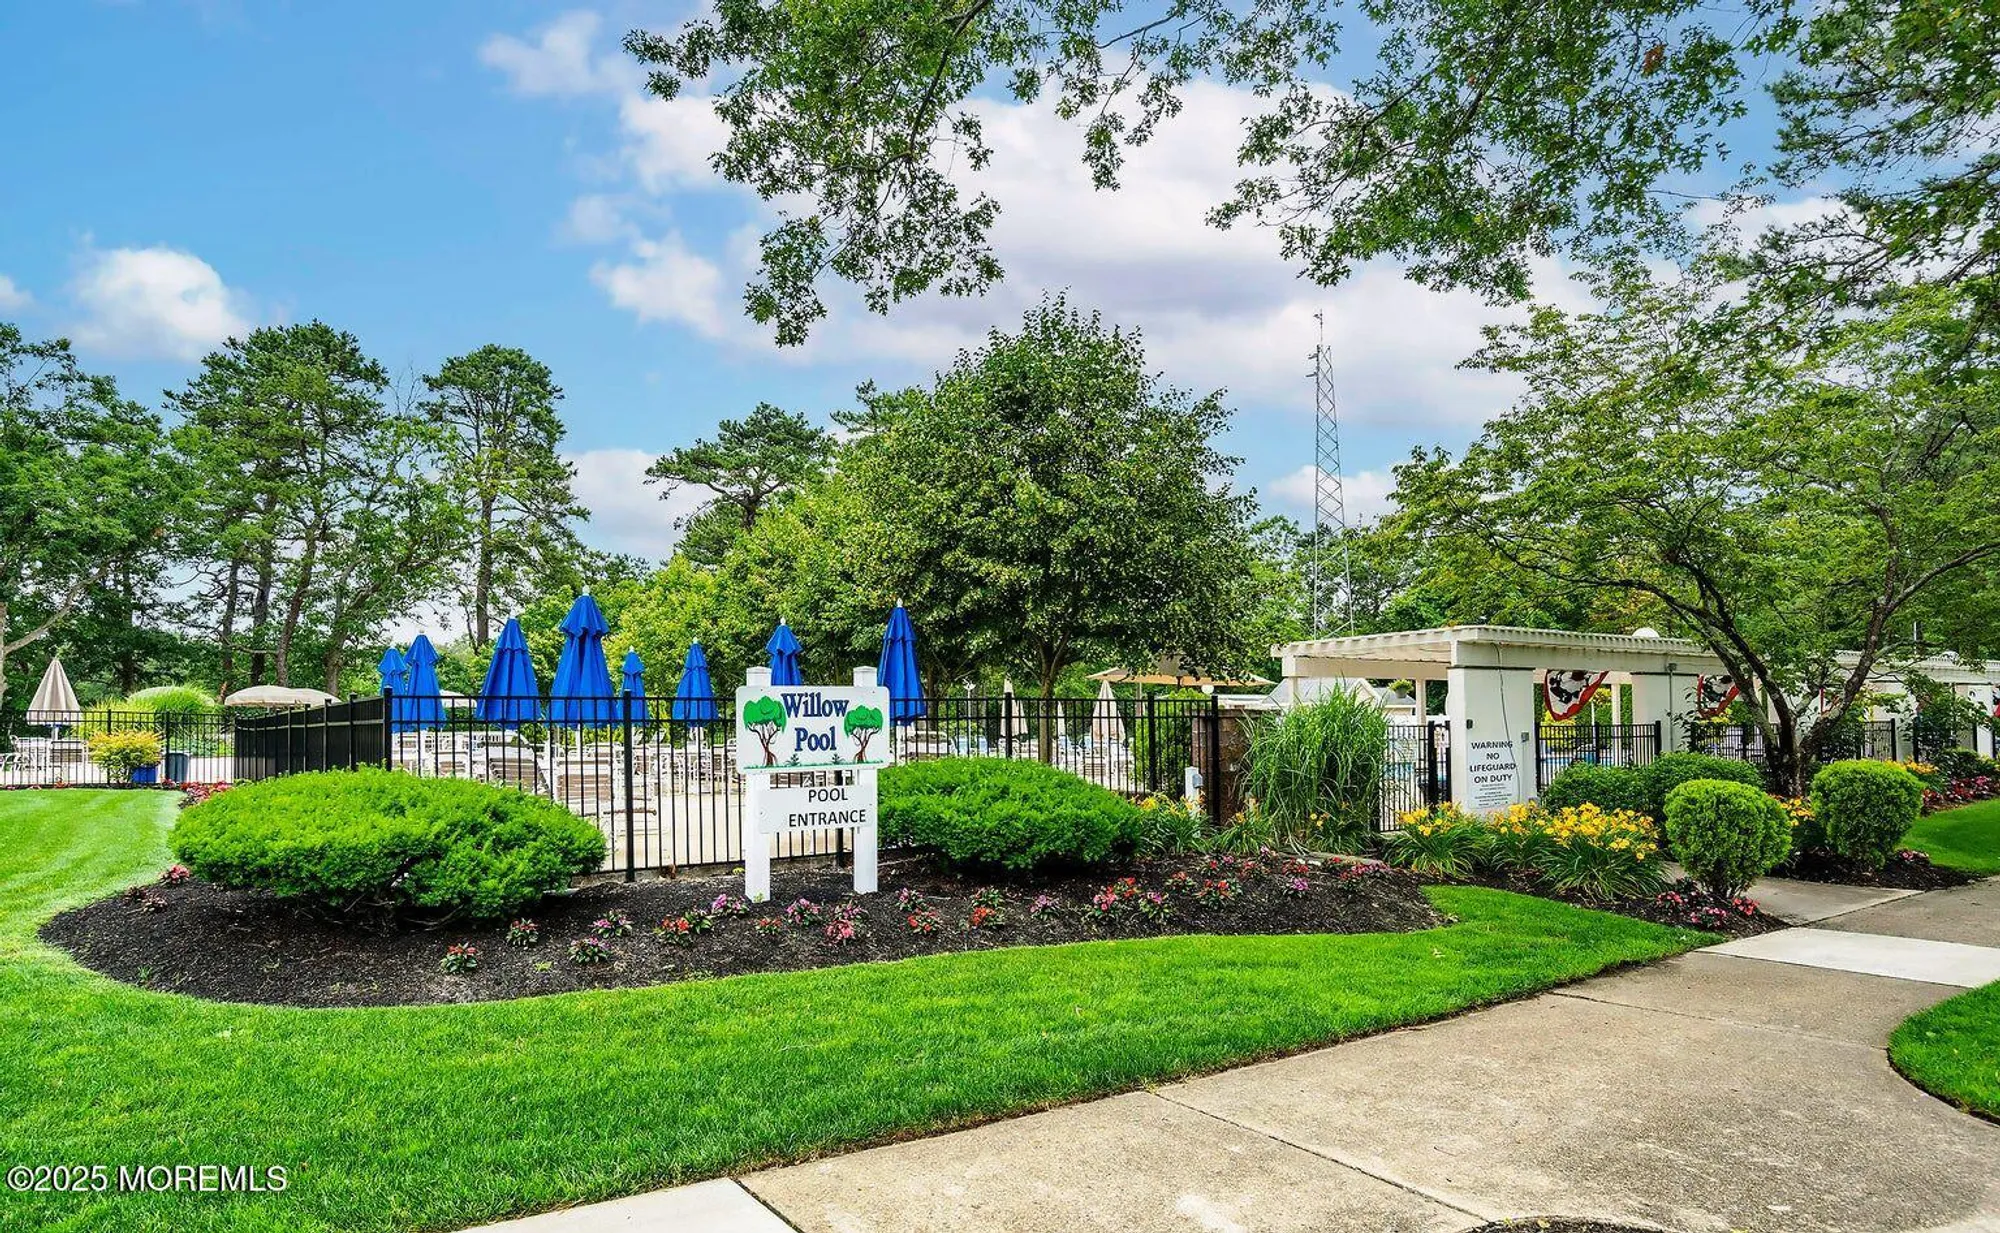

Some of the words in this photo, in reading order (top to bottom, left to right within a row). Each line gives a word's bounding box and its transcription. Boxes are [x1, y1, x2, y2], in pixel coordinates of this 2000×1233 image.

[781, 692, 850, 718] Willow
[794, 726, 837, 752] Pool
[1471, 741, 1513, 749] WARNING
[1470, 763, 1516, 772] LIFEGUARD
[1490, 774, 1512, 782] DUTY
[808, 788, 848, 802] POOL
[789, 809, 866, 827] ENTRANCE
